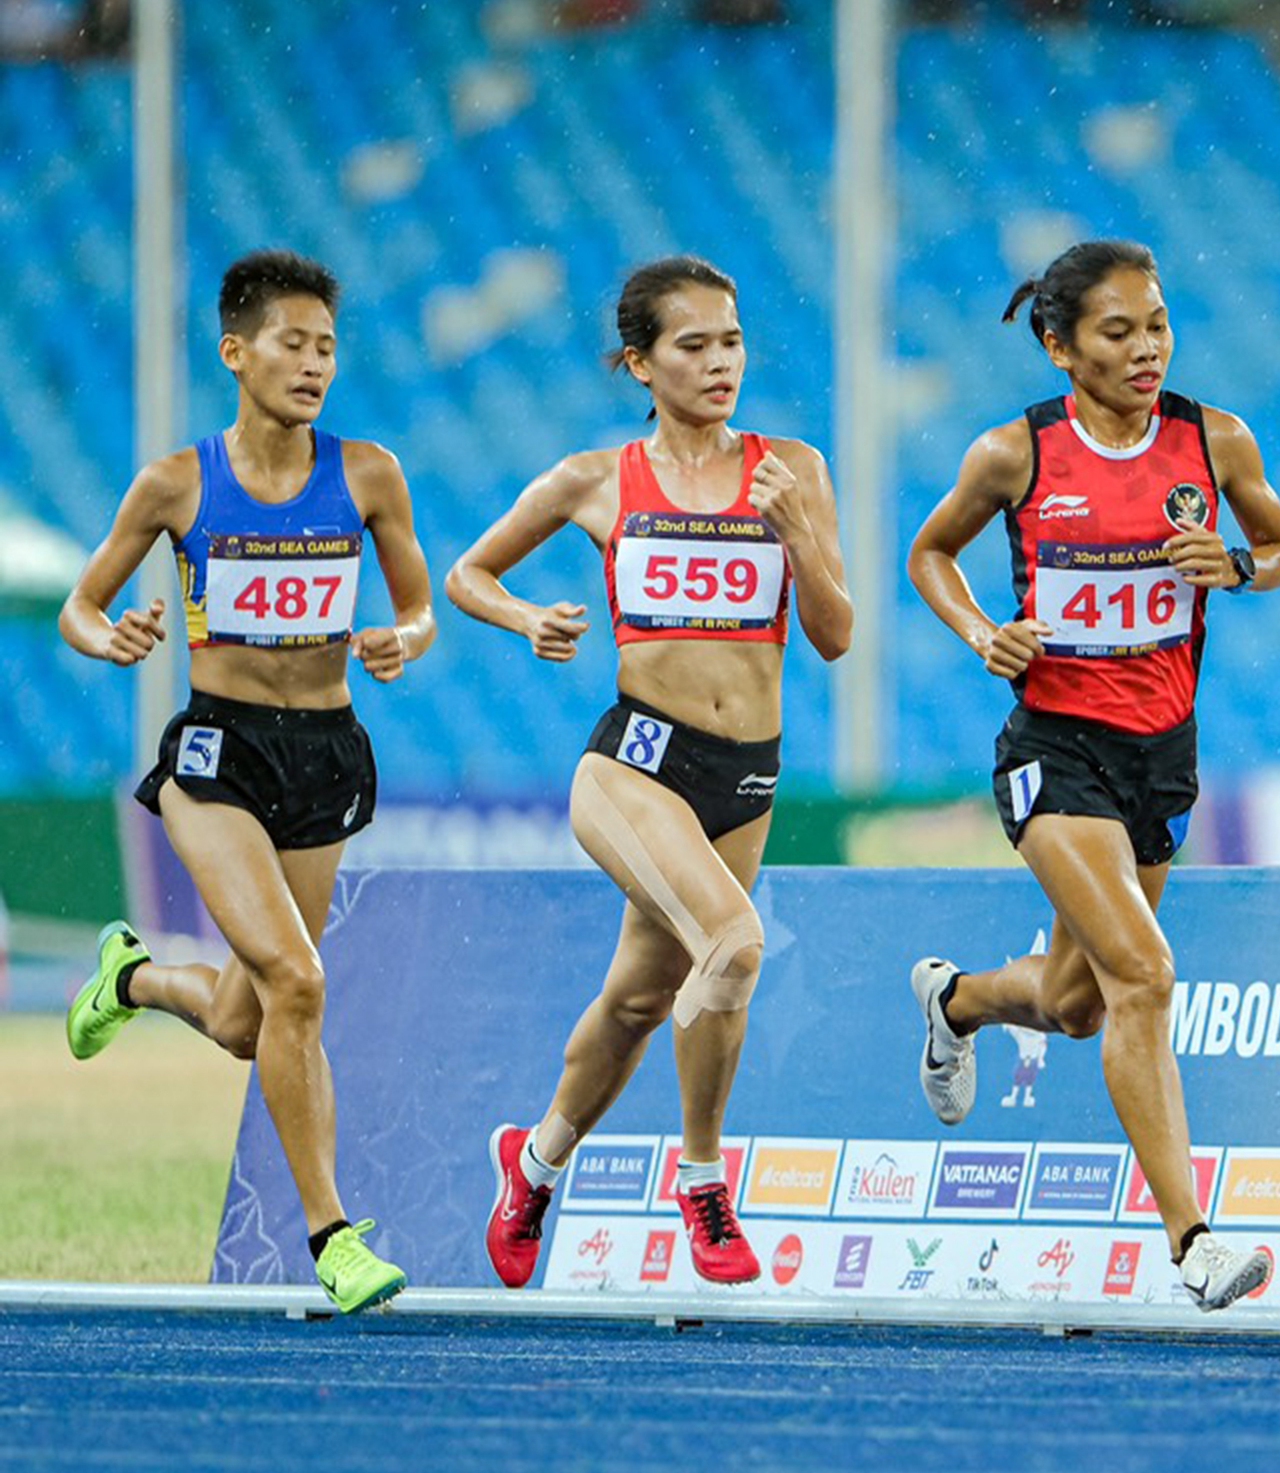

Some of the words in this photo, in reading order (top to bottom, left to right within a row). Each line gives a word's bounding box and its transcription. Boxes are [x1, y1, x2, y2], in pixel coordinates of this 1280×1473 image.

[654, 520, 685, 532] 32nd
[689, 521, 716, 534] SEA
[718, 522, 764, 535] GAMES
[245, 542, 276, 554] 32nd
[279, 541, 304, 553] SEA
[307, 540, 349, 553] GAMES
[1074, 552, 1105, 564] 32nd
[1109, 552, 1135, 564] SEA
[643, 556, 758, 604] 559
[234, 576, 342, 619] 487
[1061, 579, 1177, 629] 416
[184, 730, 216, 772] 5
[626, 719, 661, 765] 8
[1015, 768, 1033, 818] 1
[579, 1157, 605, 1173] ABA
[609, 1157, 645, 1174] BANK
[944, 1165, 1020, 1183] VATTANAC
[1041, 1166, 1068, 1182] ABA
[1074, 1166, 1111, 1183] BANK
[859, 1166, 915, 1197] Kulen
[898, 1270, 935, 1290] FBT
[967, 1277, 998, 1291] TikTok
